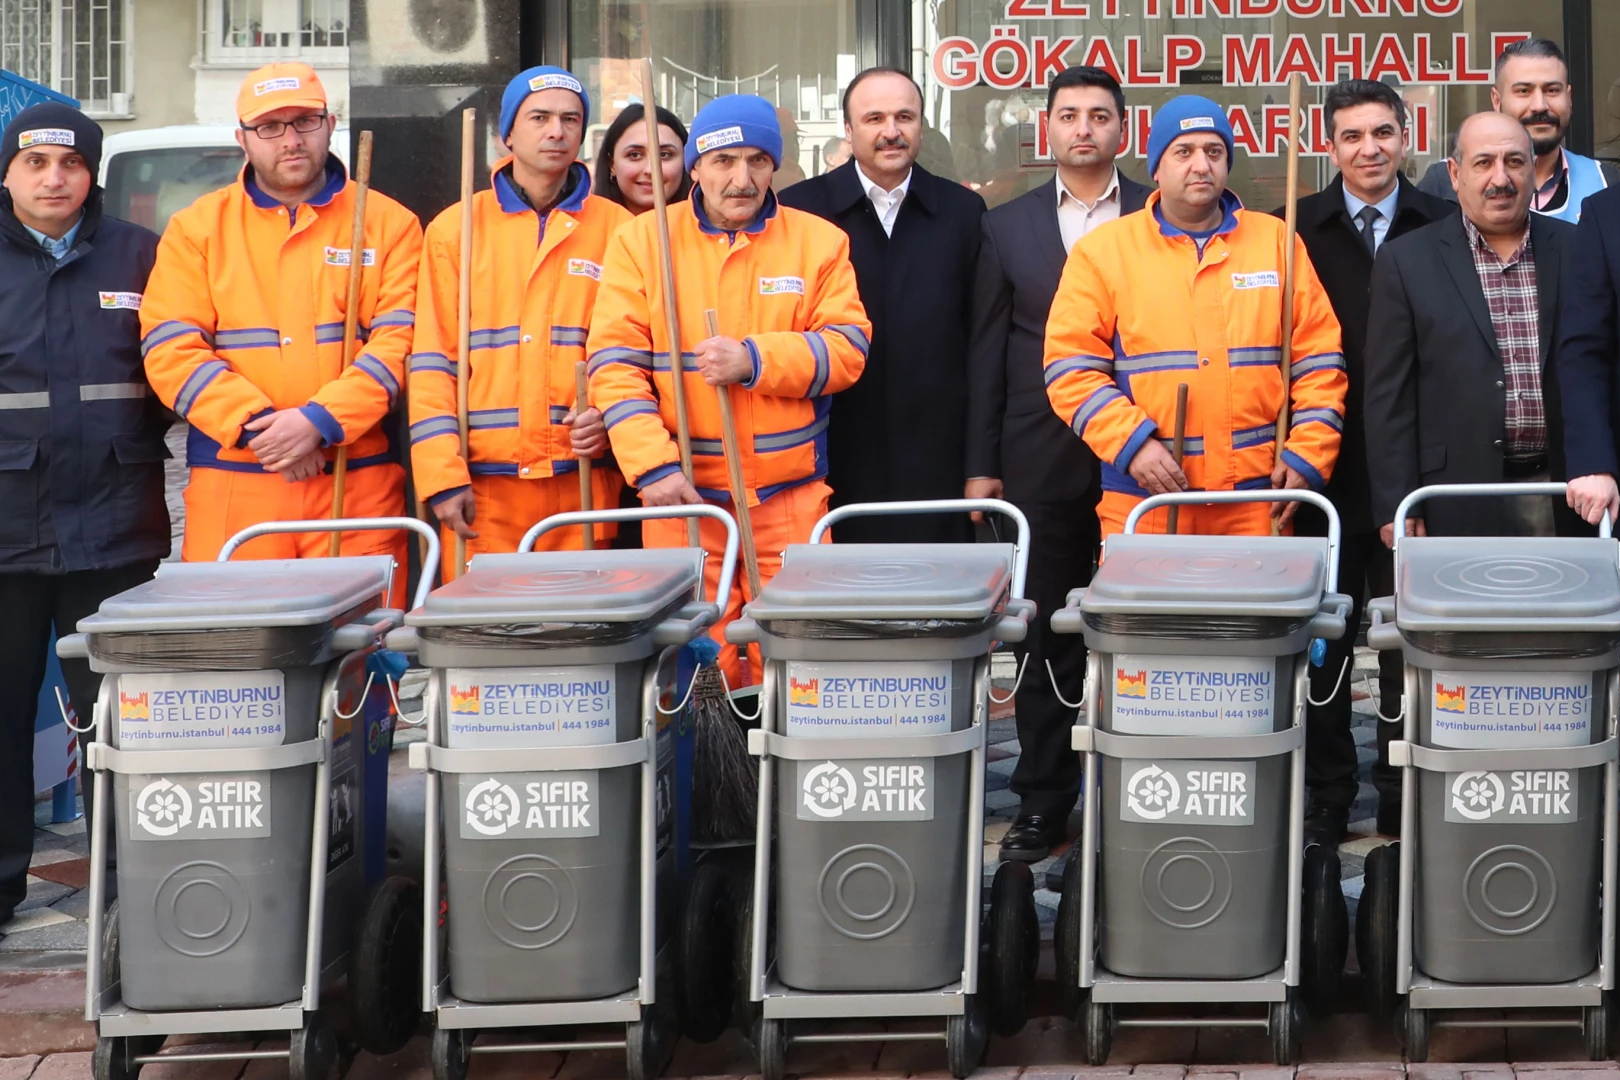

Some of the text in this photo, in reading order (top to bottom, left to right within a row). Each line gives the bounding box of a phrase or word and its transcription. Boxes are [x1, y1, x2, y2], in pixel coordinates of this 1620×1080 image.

[932, 24, 1206, 90] GÖKALP
[823, 675, 946, 693] ZEYTİNBURNU
[1151, 670, 1270, 686] ZEYTİNBURNU
[153, 685, 281, 706] ZEYTİNBURNU
[484, 680, 610, 699] ZEYTİNBURNU
[1151, 686, 1270, 702] BELEDİYESİ
[1470, 684, 1588, 701] ZEYTİNBURNU
[484, 696, 611, 716] BELEDİYESİ
[823, 692, 947, 709] BELEDİYESİ
[1470, 700, 1588, 716] BELEDİYESİ
[153, 702, 282, 722] BELEDİYESİ
[790, 713, 946, 727] zeytinburnu.istanbul 444 1984
[1116, 706, 1269, 718] zeytinburnu.istanbul 444 1984
[120, 724, 281, 740] zeytinburnu.istanbul 444 1984
[451, 718, 610, 735] zeytinburnu.istanbul 444 1984
[1436, 719, 1586, 732] zeytinburnu.istanbul 444 1984
[863, 765, 926, 787] SIFIR
[1187, 770, 1246, 793] SIFIR
[1511, 771, 1570, 792] SIFIR
[198, 780, 262, 804] SIFIR
[525, 780, 589, 804] SIFIR
[861, 788, 926, 812] ATIK
[1184, 793, 1247, 817] ATIK
[1509, 792, 1571, 815] ATIK
[197, 803, 264, 829] ATIK
[525, 803, 591, 829] ATIK
